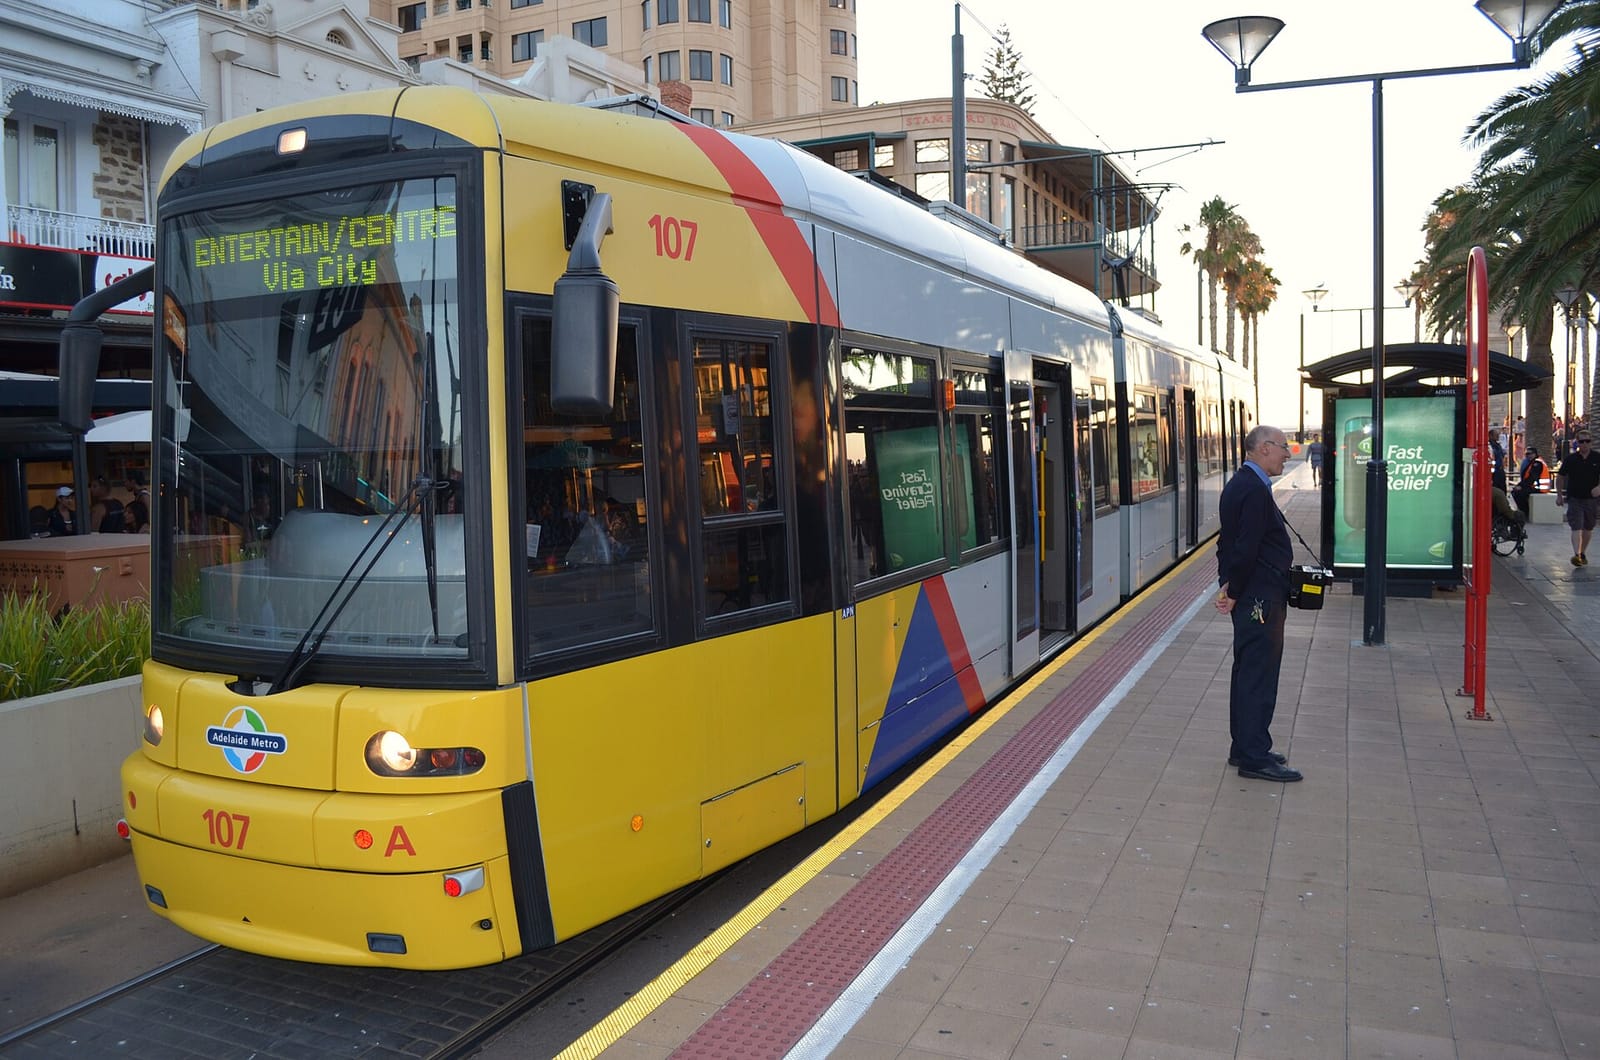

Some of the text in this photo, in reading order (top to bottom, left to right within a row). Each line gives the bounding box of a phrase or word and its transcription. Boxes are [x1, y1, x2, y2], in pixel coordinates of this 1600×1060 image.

[648, 214, 698, 262] 107
[263, 253, 377, 292] Via City
[1387, 445, 1424, 460] Fast
[1386, 460, 1449, 478] Craving
[212, 732, 279, 749] Adelaide Metro
[202, 808, 250, 850] 107
[384, 825, 416, 857] A
